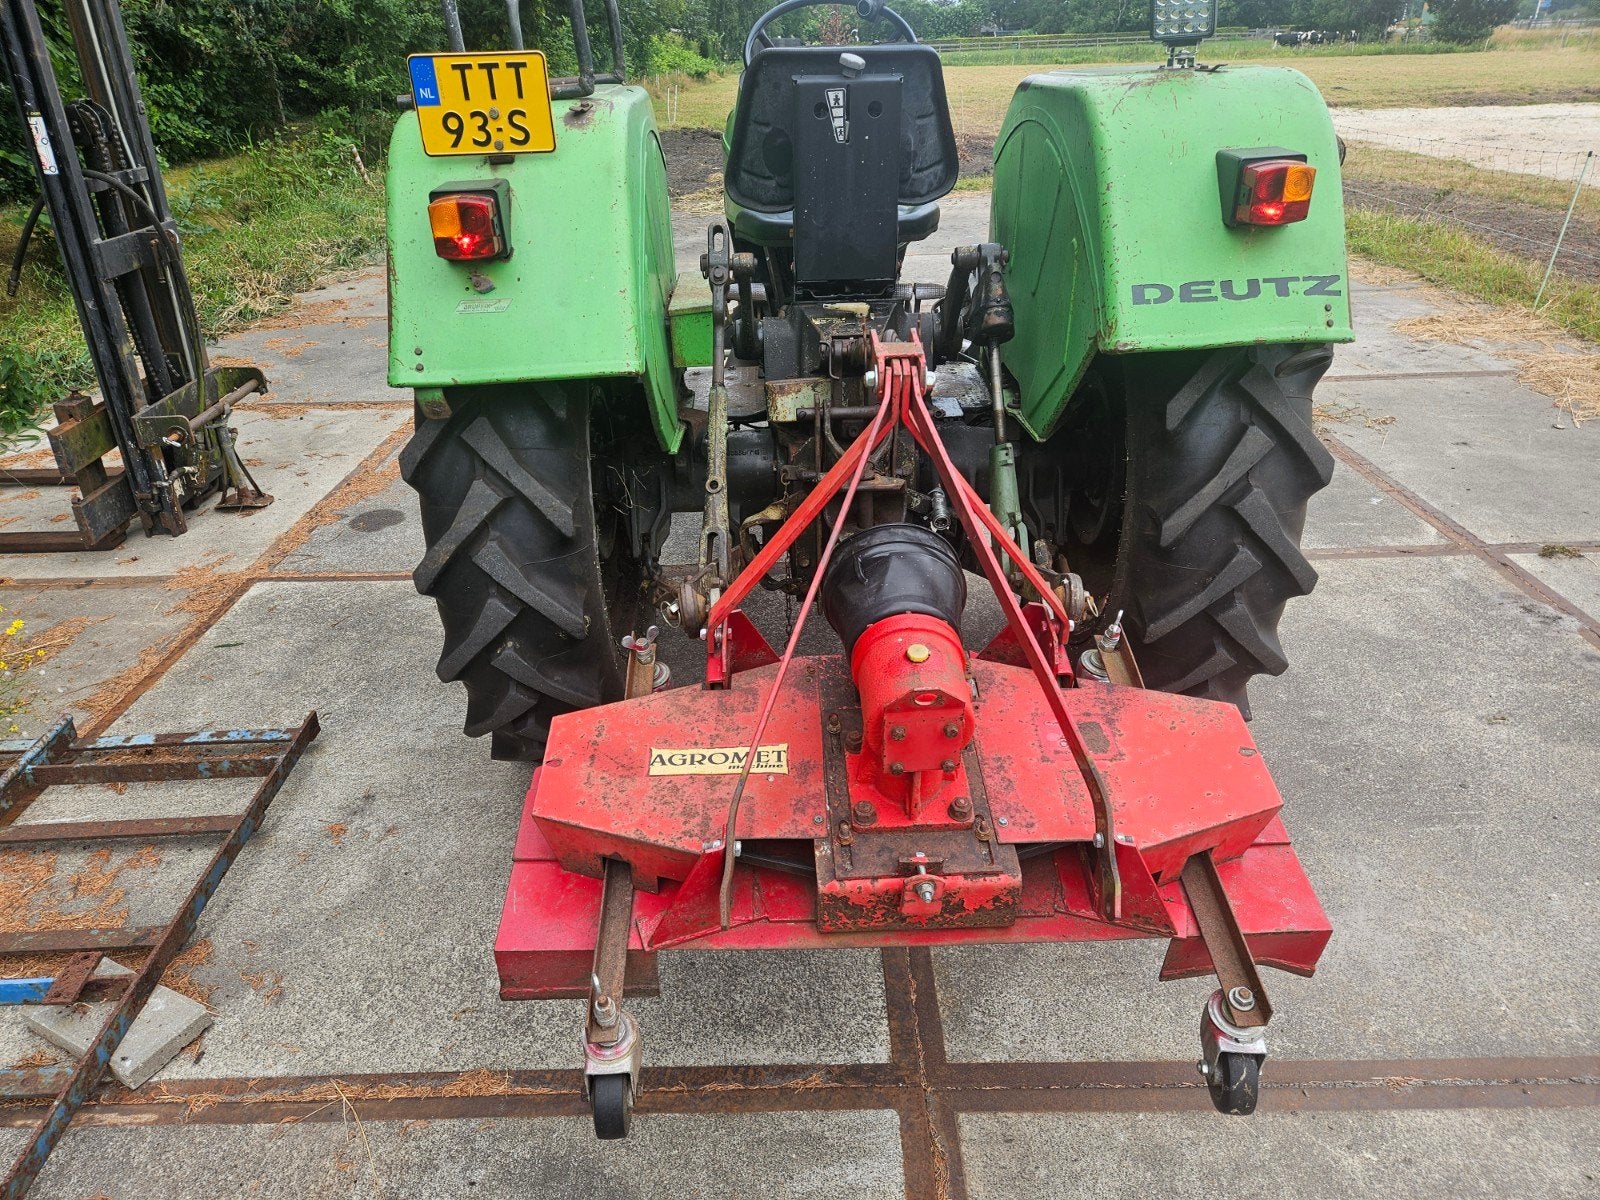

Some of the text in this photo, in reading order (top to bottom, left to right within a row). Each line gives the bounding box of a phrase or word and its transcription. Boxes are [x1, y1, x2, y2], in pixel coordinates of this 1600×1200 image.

[419, 87, 435, 99] NL
[451, 61, 527, 101] TTT
[441, 109, 531, 148] 93-S
[1131, 274, 1342, 306] DEUTZ
[650, 750, 787, 767] AGROMET
